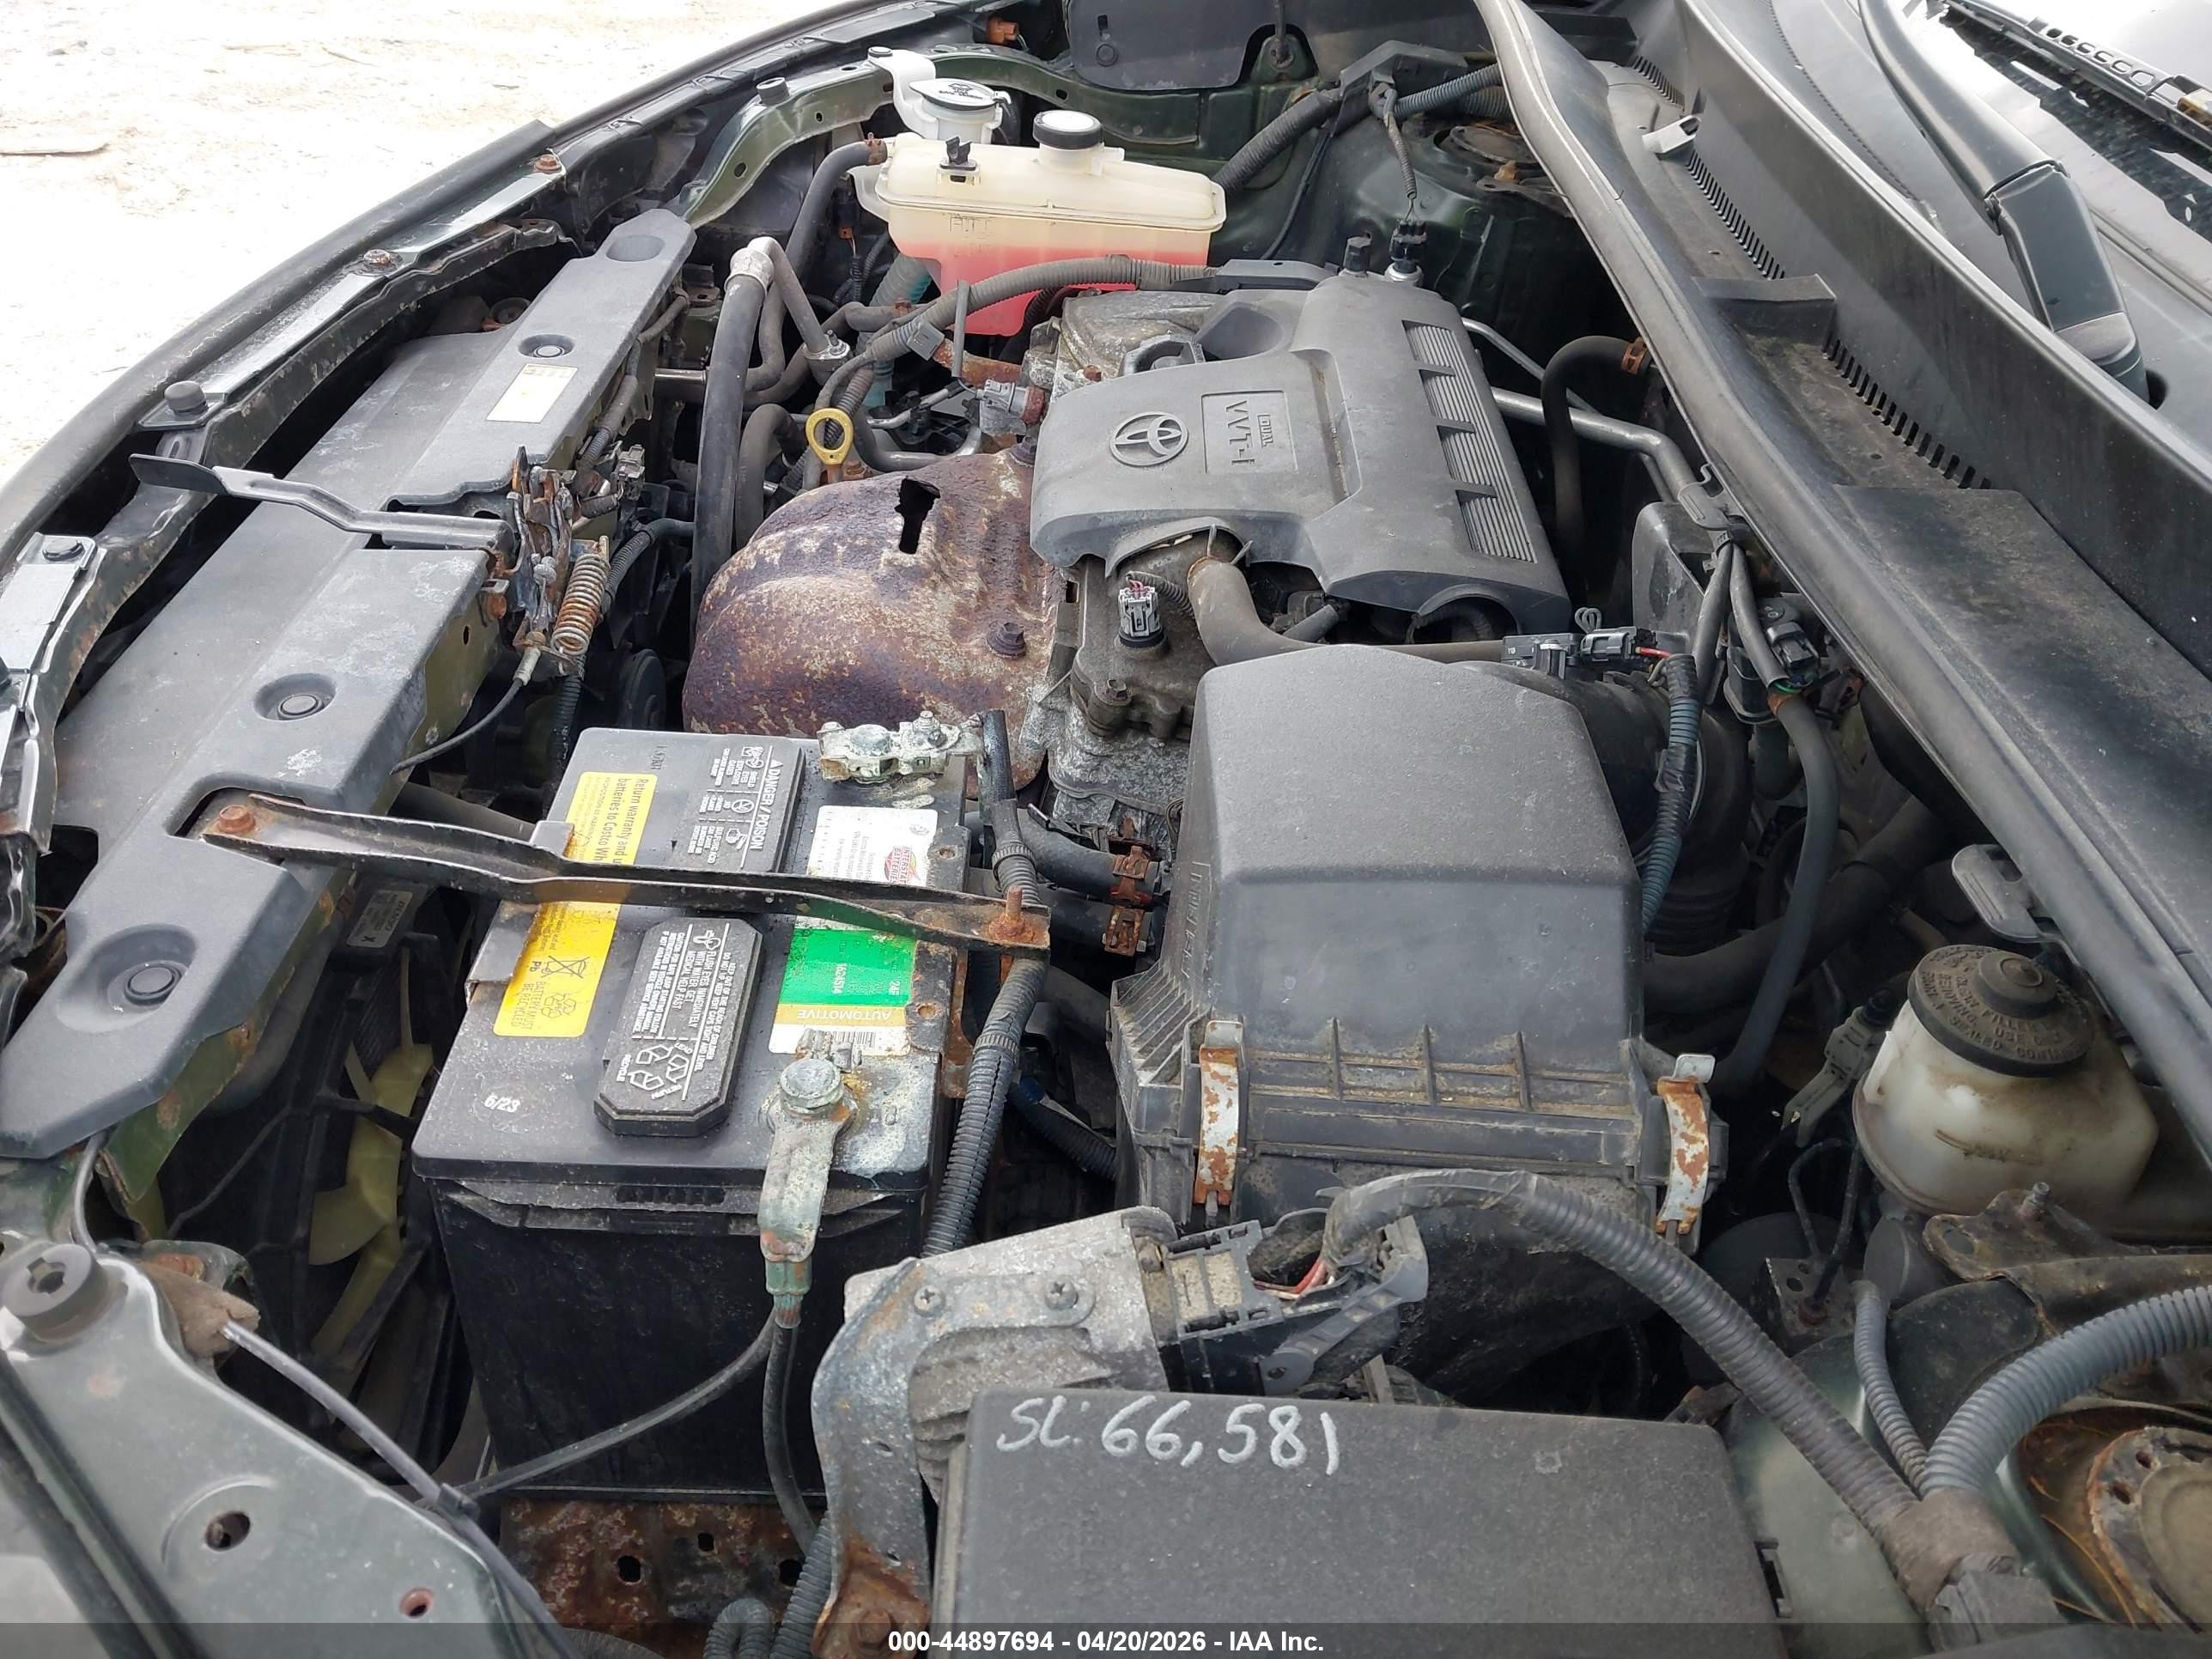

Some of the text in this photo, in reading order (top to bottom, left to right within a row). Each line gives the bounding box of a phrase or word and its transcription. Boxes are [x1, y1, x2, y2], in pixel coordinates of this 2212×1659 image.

[1257, 415, 1273, 447] DUAL
[610, 778, 631, 811] batteries
[631, 778, 649, 804] Return
[761, 769, 781, 805] DANGER
[617, 805, 638, 839] warranty
[750, 814, 770, 848] POISON
[599, 822, 617, 846] Costco
[614, 841, 628, 856] and
[708, 826, 724, 863] SULFURIC ACID
[897, 847, 912, 885] INTERSTAT
[659, 936, 667, 945] NOT
[529, 960, 542, 972] Pb
[694, 951, 706, 965] WITH
[720, 961, 729, 969] NOT
[672, 951, 696, 1009] MEDICAL HELP FAST
[688, 951, 716, 1027] FLUSH EYES IMMEDIATELY
[714, 982, 723, 995] KEEP
[724, 975, 732, 985] OUT
[521, 981, 546, 1030] BATTERY MUST
[684, 990, 696, 1002] GET
[710, 996, 720, 1008] VENT
[720, 996, 728, 1006] THE
[510, 994, 531, 1026] RECYCLED
[707, 1010, 716, 1024] CAPS
[714, 1007, 726, 1024] REACH
[797, 1009, 891, 1019] AUTOMOTIVE
[650, 1013, 661, 1033] FOLLOW
[702, 1026, 713, 1042] TIGHT
[699, 1042, 708, 1053] AND
[484, 1091, 521, 1113] 6/23
[1102, 1395, 1340, 1474] 66,581
